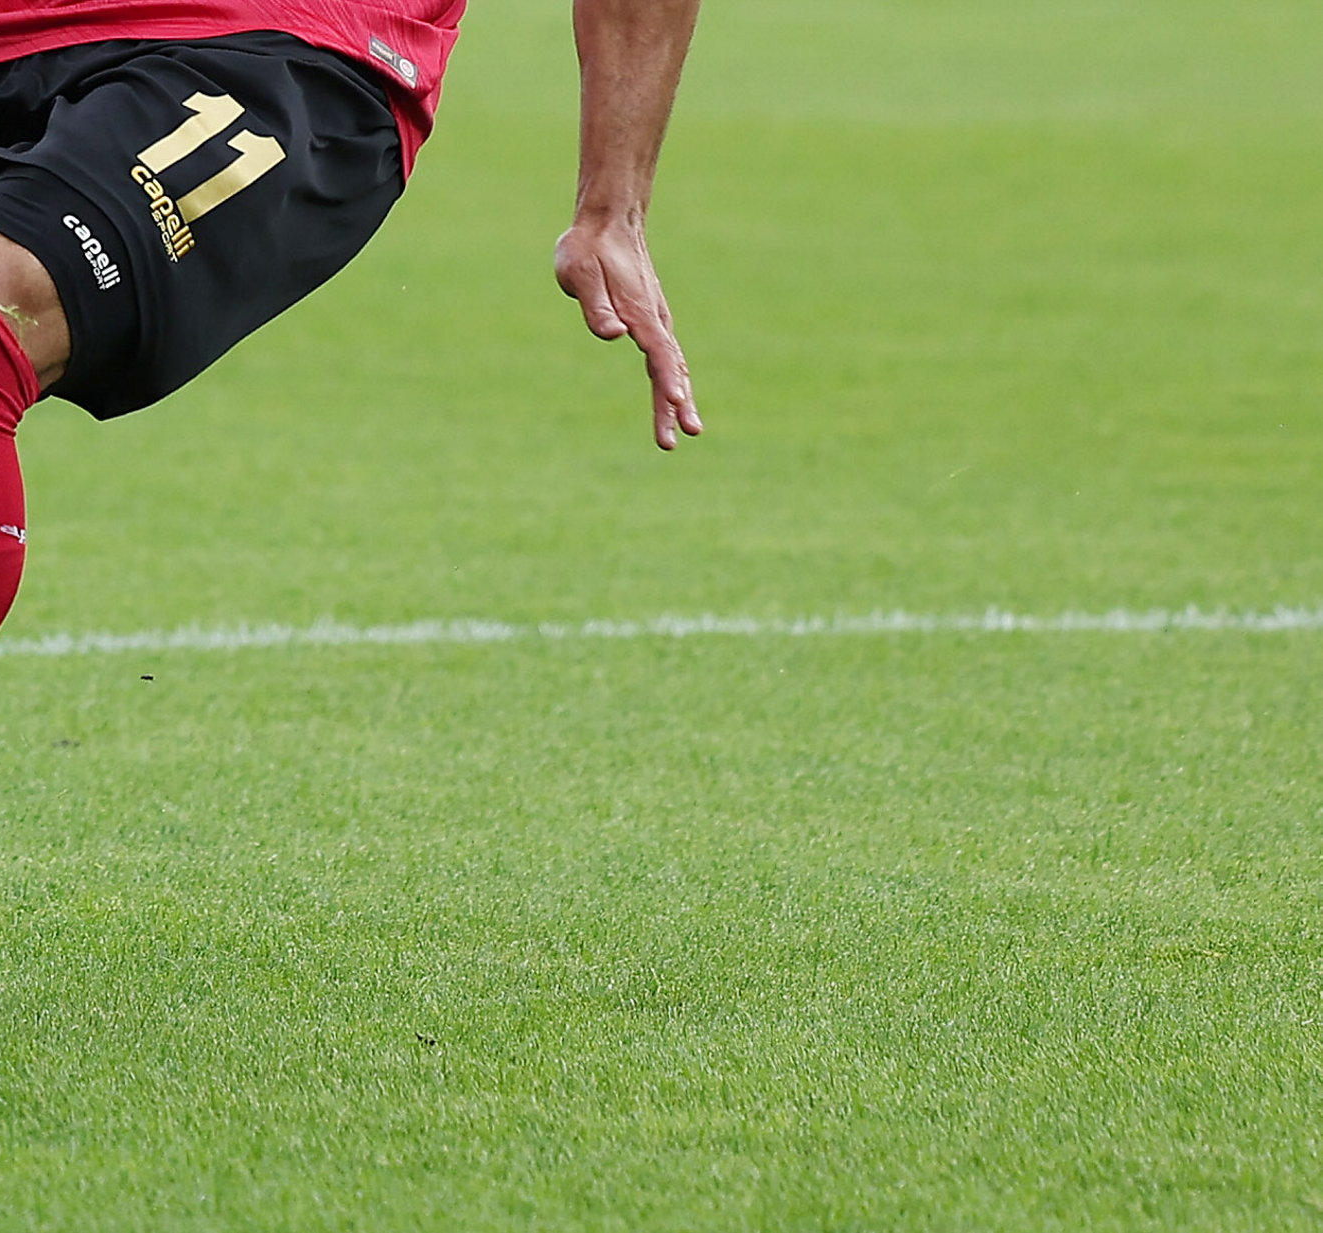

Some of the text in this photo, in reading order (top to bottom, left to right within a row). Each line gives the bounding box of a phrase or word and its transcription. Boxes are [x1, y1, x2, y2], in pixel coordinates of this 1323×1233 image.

[136, 92, 287, 225] 11
[130, 165, 196, 260] capelli
[151, 213, 179, 263] SPORT
[63, 214, 121, 289] capelli
[83, 251, 107, 291] SPORT
